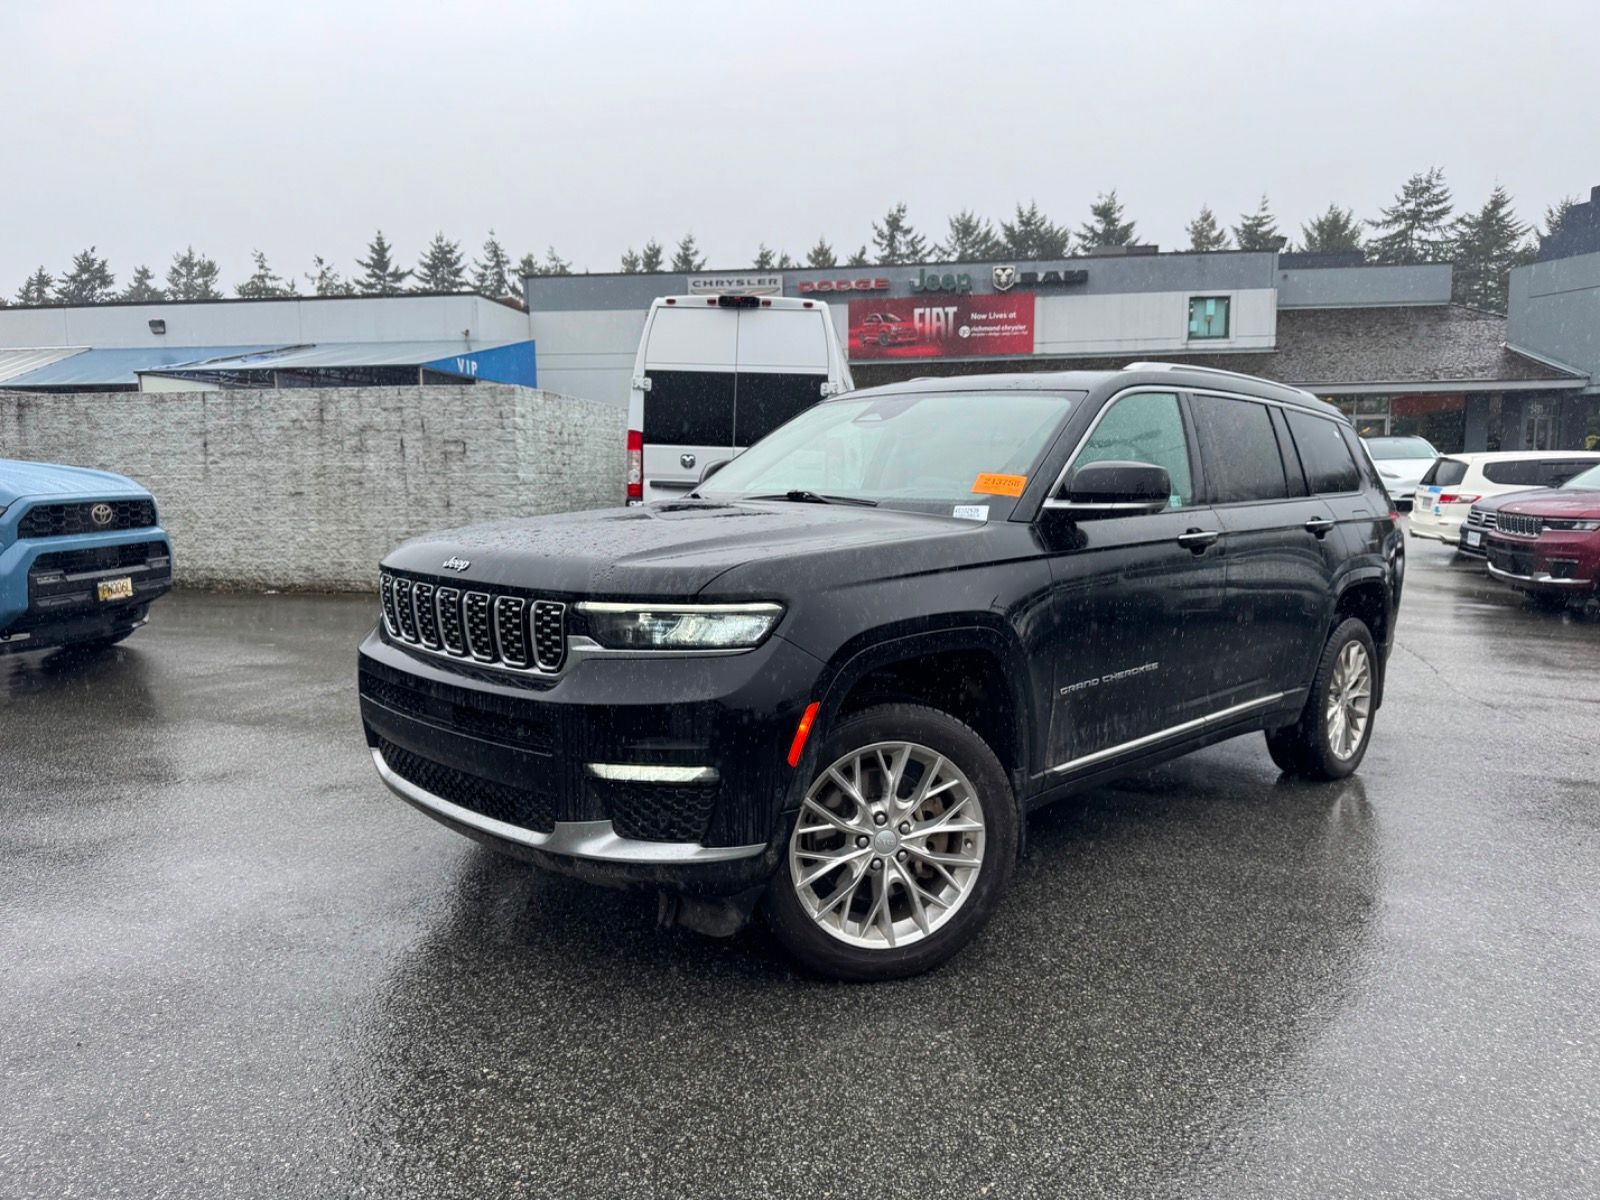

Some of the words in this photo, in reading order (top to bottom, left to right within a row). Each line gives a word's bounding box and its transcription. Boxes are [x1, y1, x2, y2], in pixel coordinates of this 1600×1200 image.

[691, 278, 779, 288] CHRYSLER
[798, 277, 891, 293] DODGE
[909, 268, 973, 294] Jeep
[1019, 270, 1089, 285] RAM
[913, 306, 958, 338] FIAT
[970, 312, 988, 320] Now
[988, 311, 1007, 320] Lives
[1008, 311, 1017, 319] at
[456, 357, 478, 376] VIP
[442, 556, 470, 572] Jeep
[1059, 678, 1100, 695] GRAND
[1101, 661, 1159, 683] CHEROKEE
